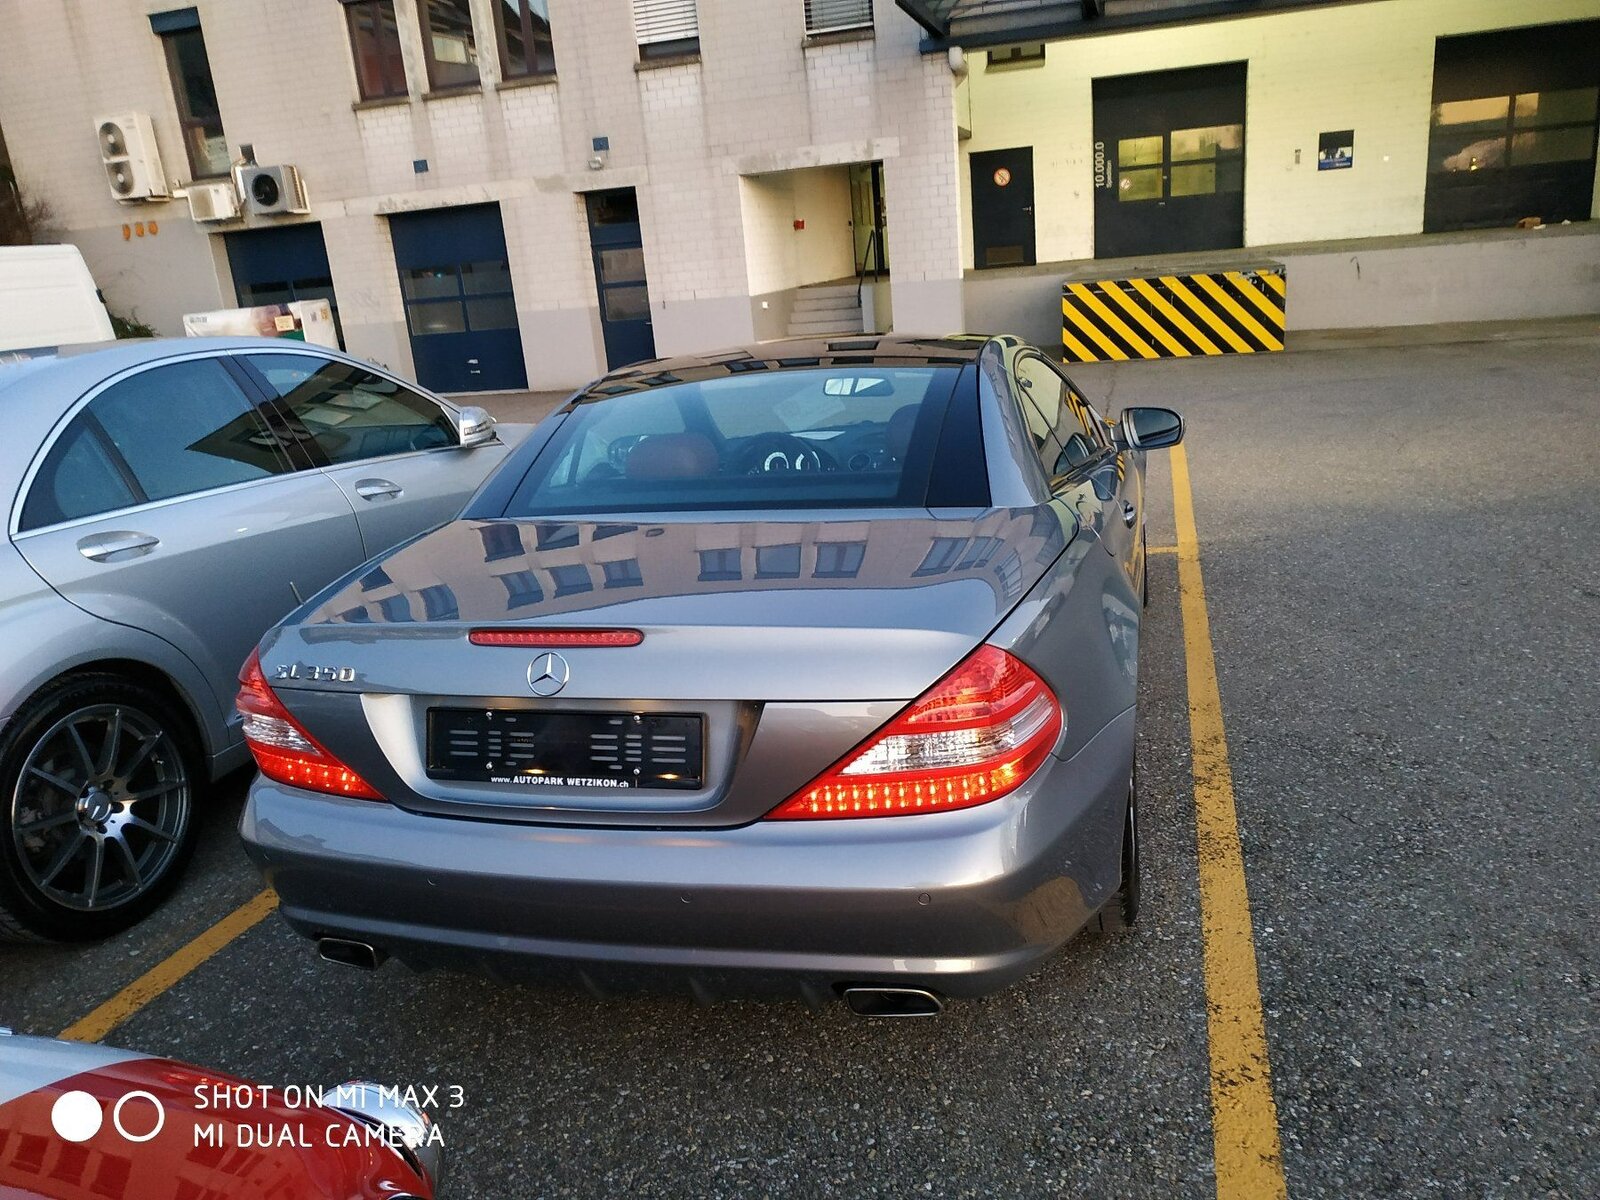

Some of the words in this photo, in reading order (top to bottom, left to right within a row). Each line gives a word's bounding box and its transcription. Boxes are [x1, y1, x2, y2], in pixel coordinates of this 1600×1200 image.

[275, 664, 300, 680] SL
[305, 665, 355, 682] 350
[566, 777, 629, 788] WETZIKON.ch
